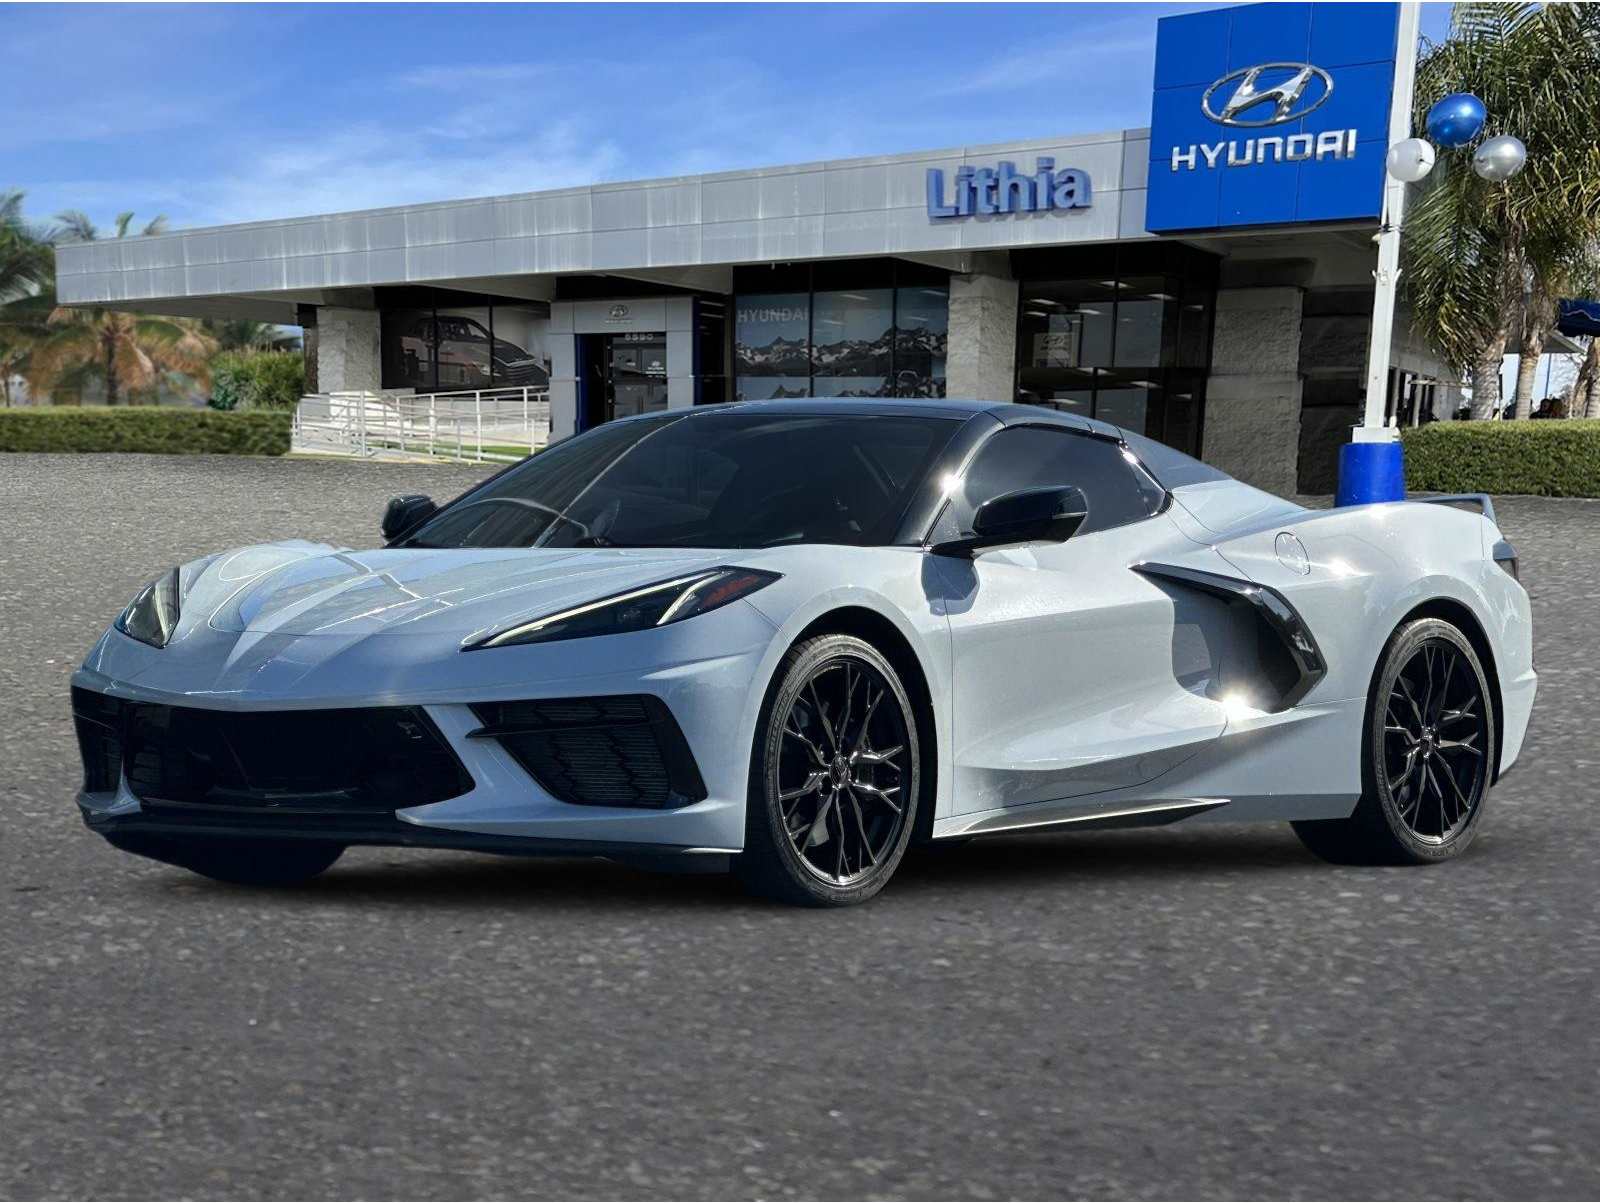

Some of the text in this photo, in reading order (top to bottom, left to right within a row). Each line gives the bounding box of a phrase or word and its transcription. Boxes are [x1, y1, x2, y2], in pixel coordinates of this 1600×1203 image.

[1171, 128, 1357, 171] HYUNDAI
[925, 157, 1092, 219] Lithia
[737, 309, 808, 321] HYUNDAI
